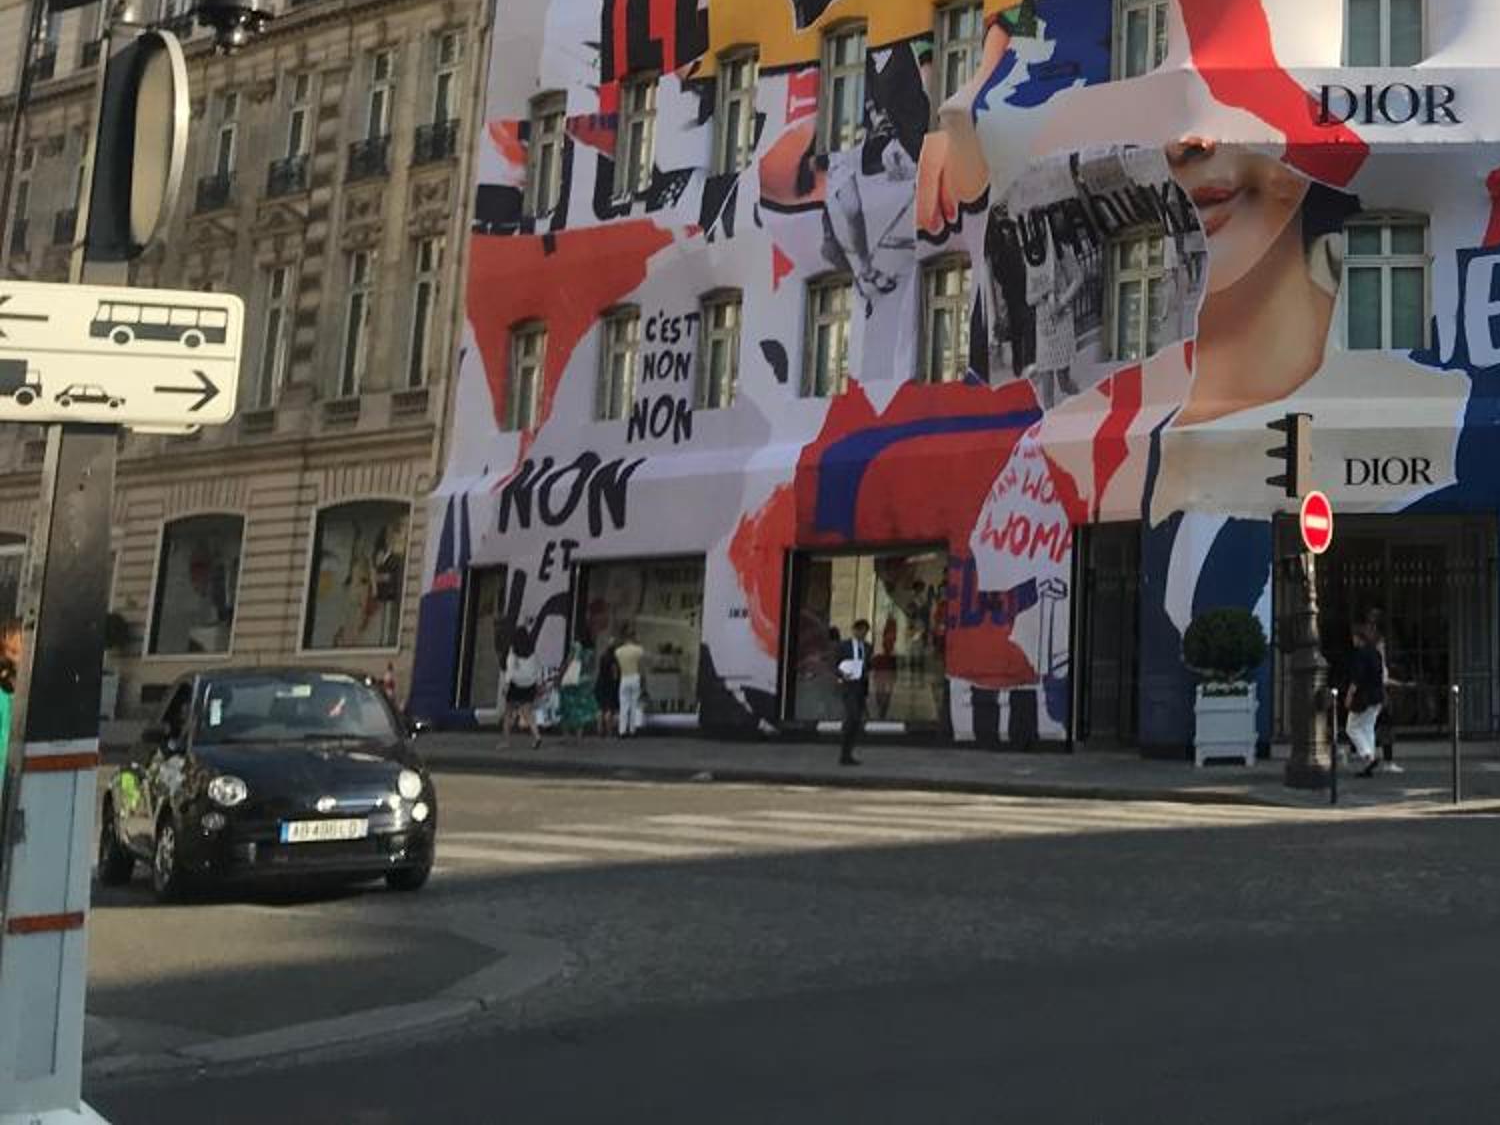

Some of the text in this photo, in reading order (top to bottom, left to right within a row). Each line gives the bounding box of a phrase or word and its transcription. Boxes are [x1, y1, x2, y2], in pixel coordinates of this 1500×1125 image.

[1315, 82, 1463, 127] DIOR
[646, 311, 699, 343] C'EST
[643, 349, 690, 381] NON
[627, 394, 693, 444] NON
[1345, 458, 1434, 486] DIOR
[499, 451, 648, 537] NON
[539, 539, 579, 581] ET
